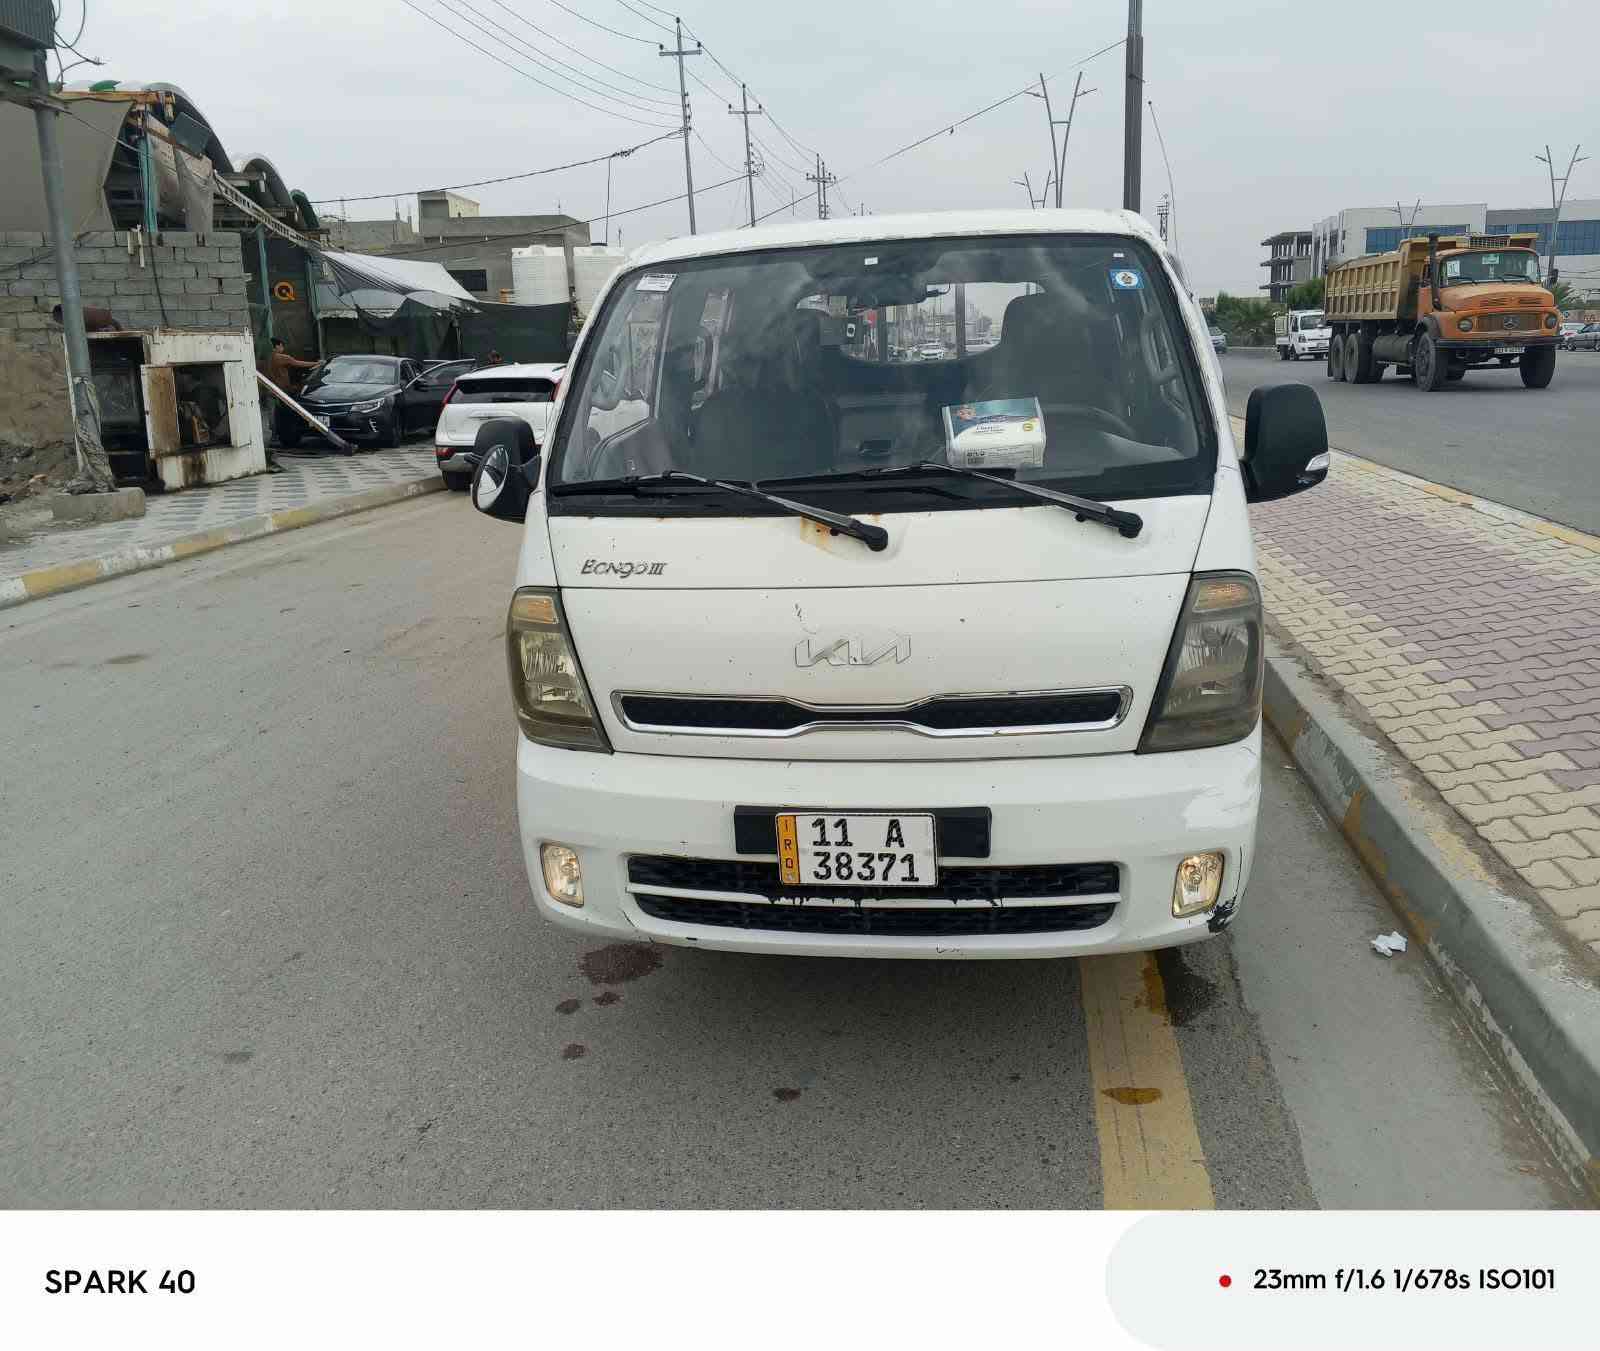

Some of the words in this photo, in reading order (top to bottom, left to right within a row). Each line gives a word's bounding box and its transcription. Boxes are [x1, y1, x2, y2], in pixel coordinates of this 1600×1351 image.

[794, 635, 912, 668] KIA
[811, 818, 854, 848] 11
[885, 818, 906, 849] A
[812, 851, 920, 883] 38371
